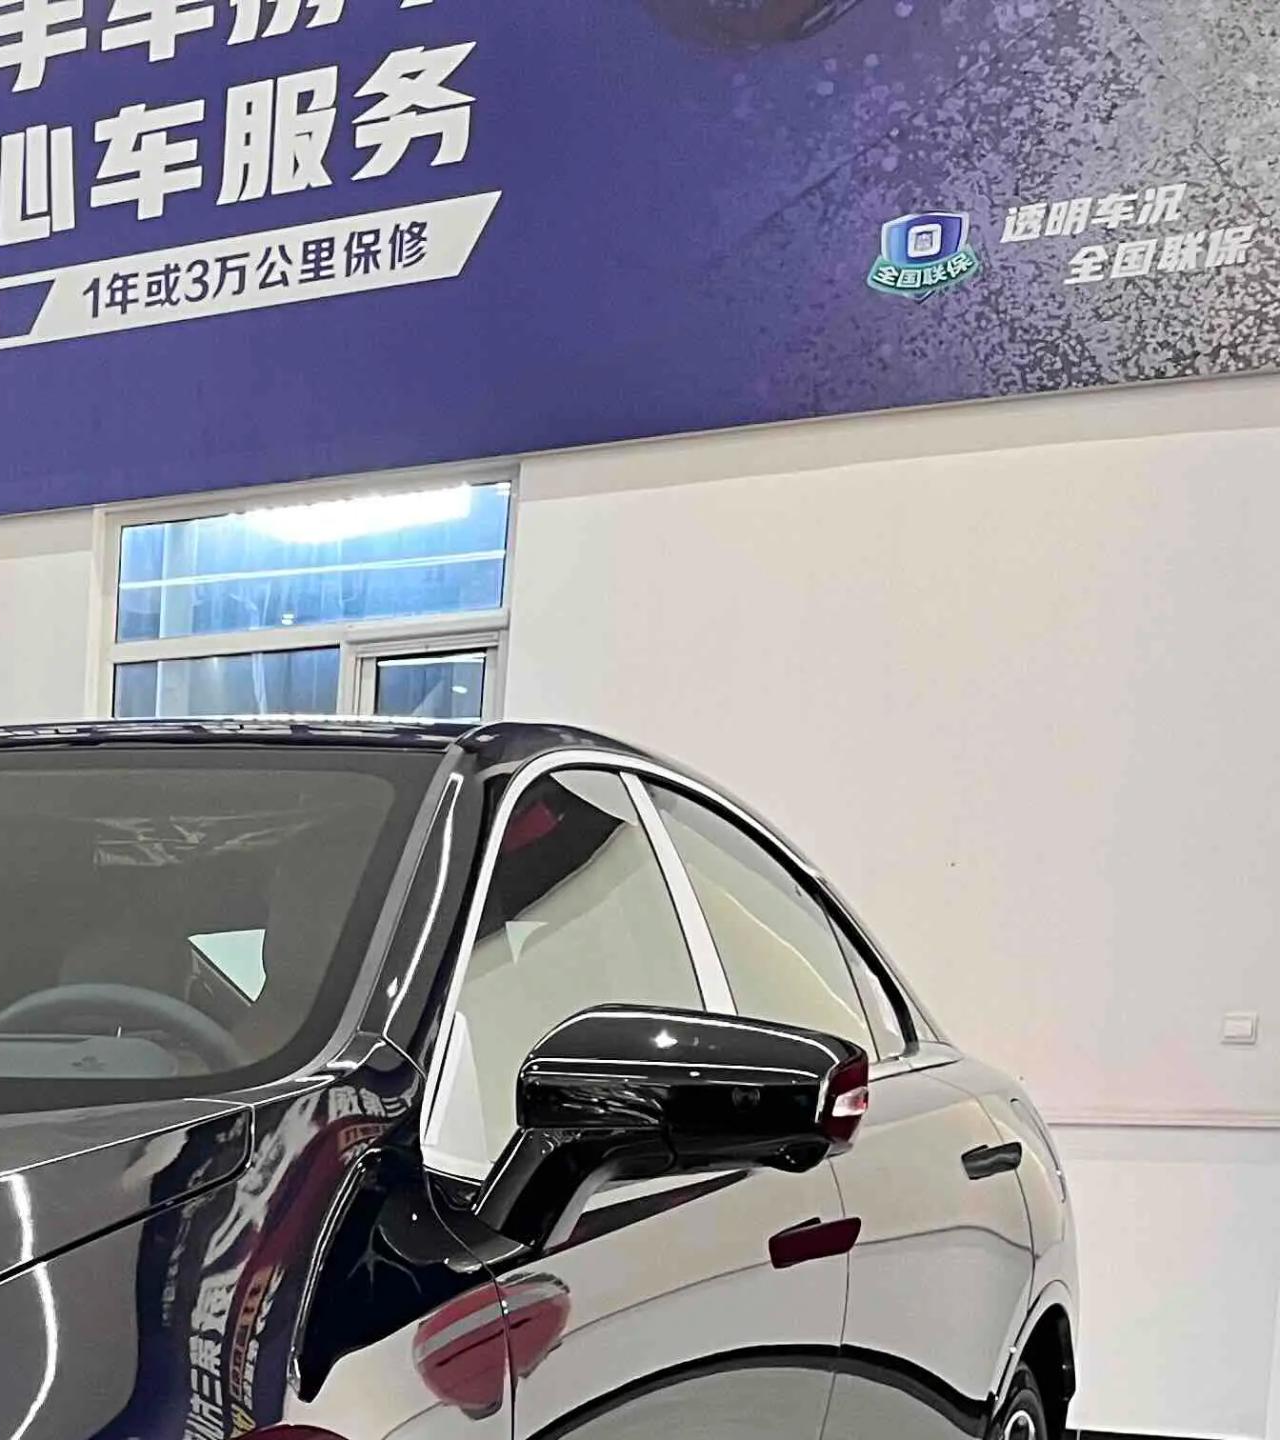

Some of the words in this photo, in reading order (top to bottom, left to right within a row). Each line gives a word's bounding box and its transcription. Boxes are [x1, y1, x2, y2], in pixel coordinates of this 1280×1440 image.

[1000, 183, 1188, 243] 透明车况
[81, 219, 430, 320] 1年或3万公里保修
[873, 253, 974, 288] 全国联保
[1063, 225, 1258, 285] 全国联保
